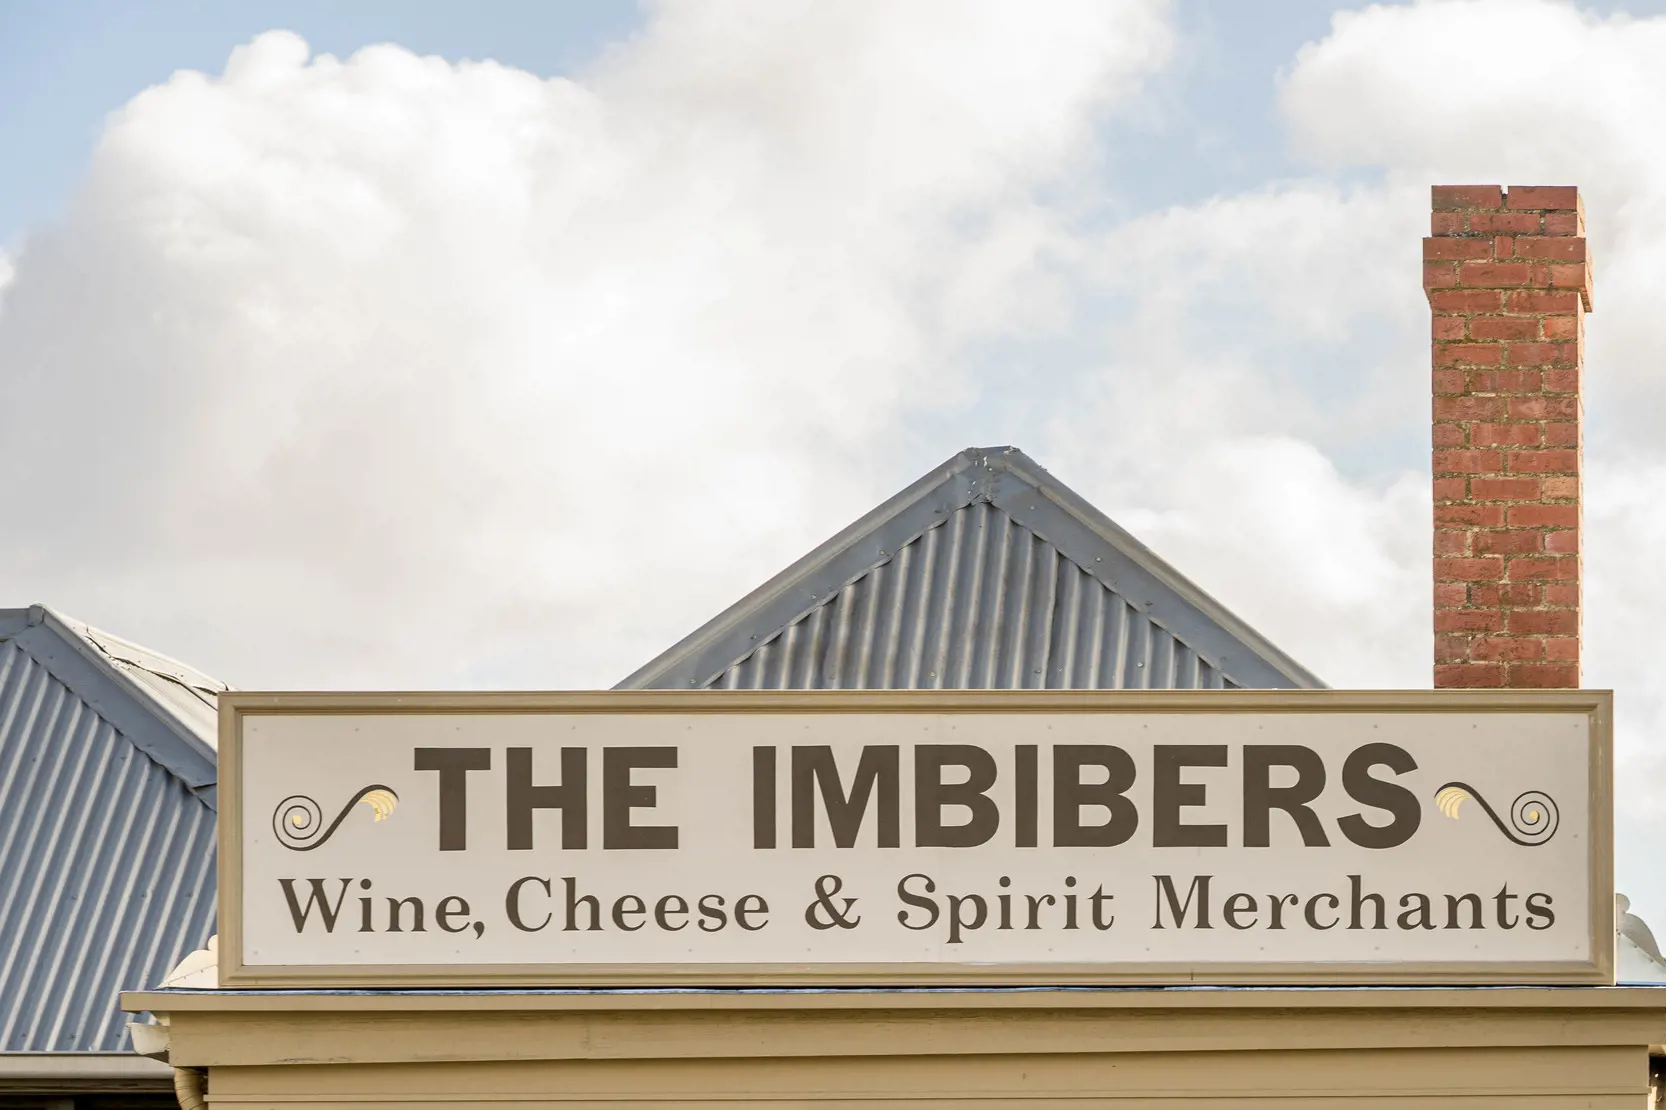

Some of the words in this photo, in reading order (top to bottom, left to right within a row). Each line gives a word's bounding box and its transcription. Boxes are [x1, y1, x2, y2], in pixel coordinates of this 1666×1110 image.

[413, 745, 679, 852] THE
[752, 742, 1422, 850] IMBIBERS
[278, 878, 486, 939] Wine,
[505, 875, 770, 933] Cheese
[804, 873, 862, 932] &
[897, 873, 1115, 944] Spirit
[1151, 873, 1556, 931] Merchants
